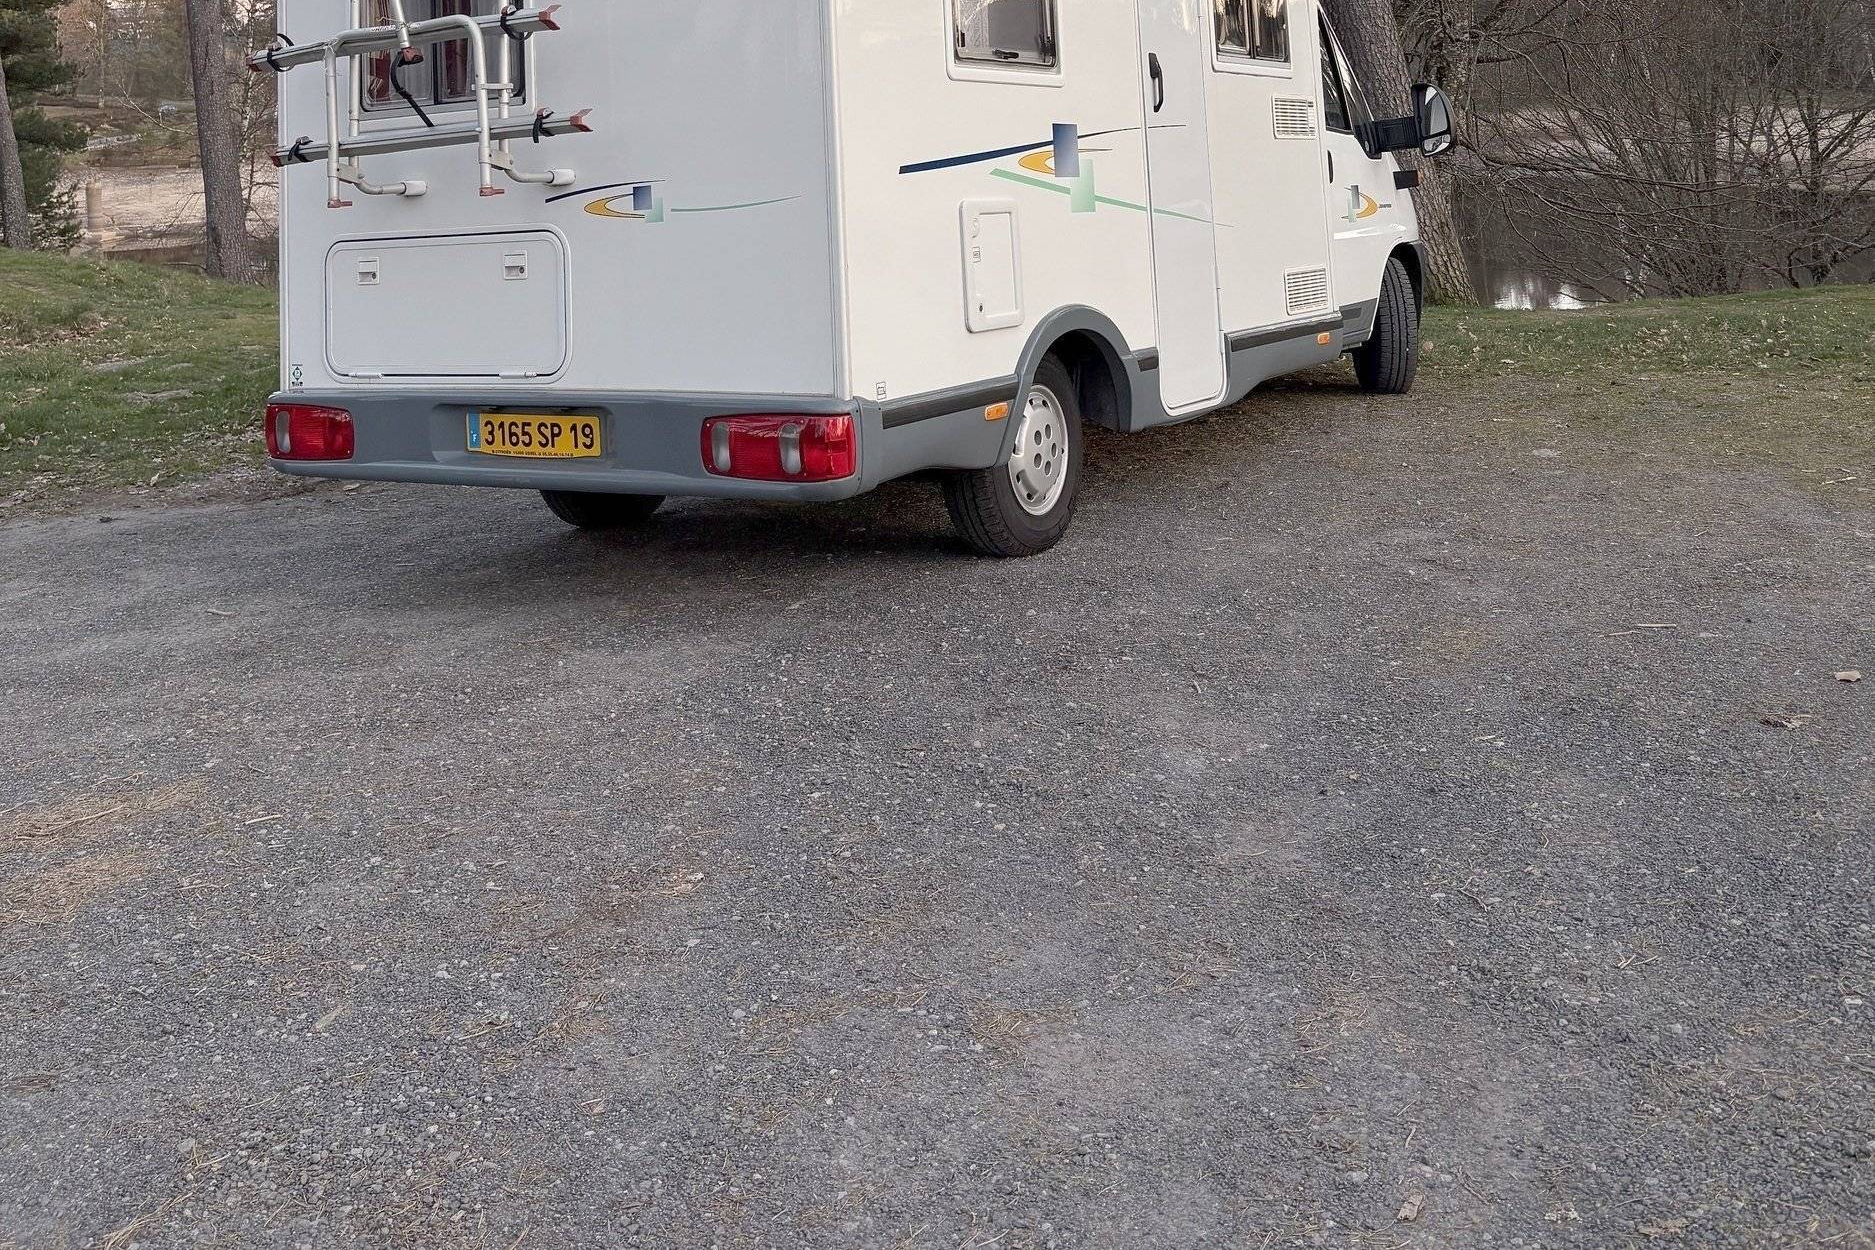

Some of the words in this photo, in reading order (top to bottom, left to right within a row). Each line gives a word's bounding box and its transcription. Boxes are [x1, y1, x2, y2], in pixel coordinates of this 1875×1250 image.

[484, 420, 533, 448] 3165
[537, 422, 563, 449] SP
[569, 423, 595, 450] 19
